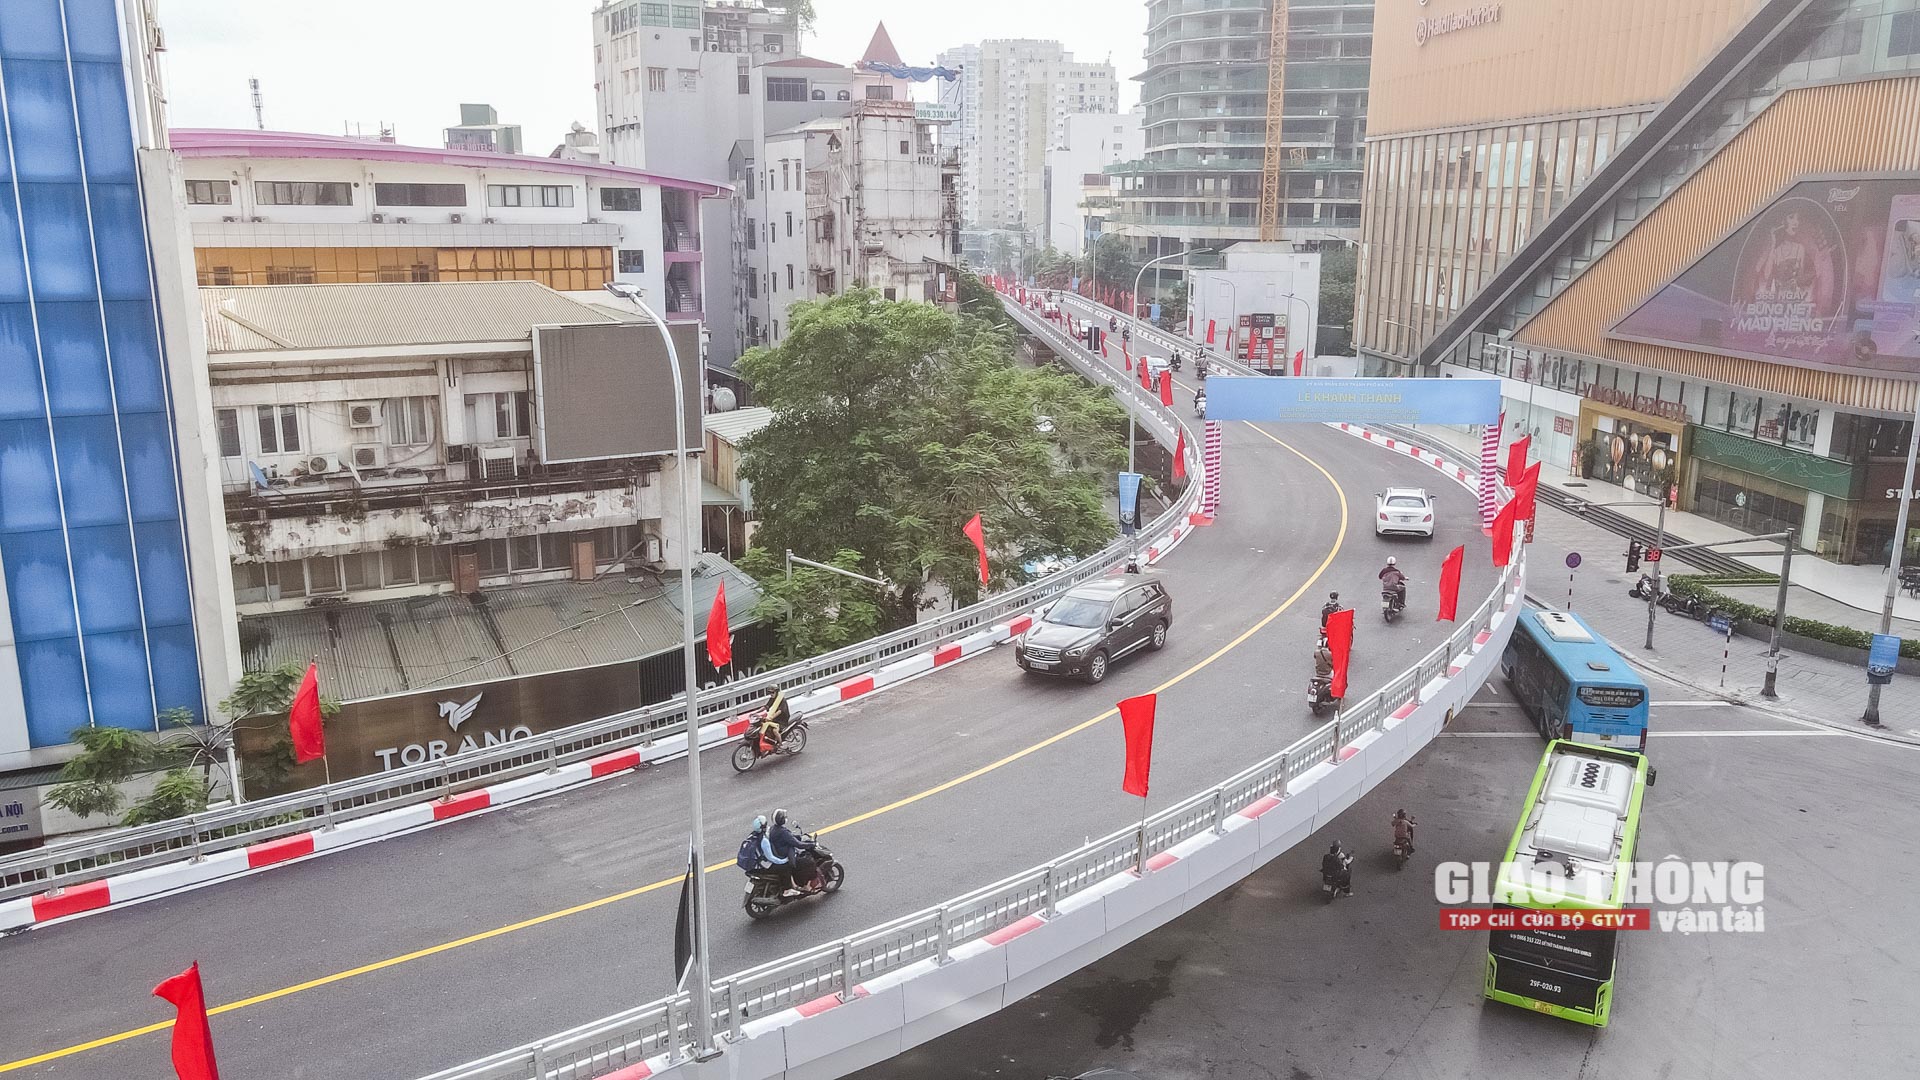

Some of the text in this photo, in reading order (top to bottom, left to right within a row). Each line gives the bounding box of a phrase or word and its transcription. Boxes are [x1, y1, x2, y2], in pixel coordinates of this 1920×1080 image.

[1755, 292, 1775, 300] 365
[1583, 381, 1633, 409] VINCOM
[1647, 550, 1660, 561] 38
[5, 800, 24, 818] NỘI
[1529, 979, 1562, 993] 29F-020.93
